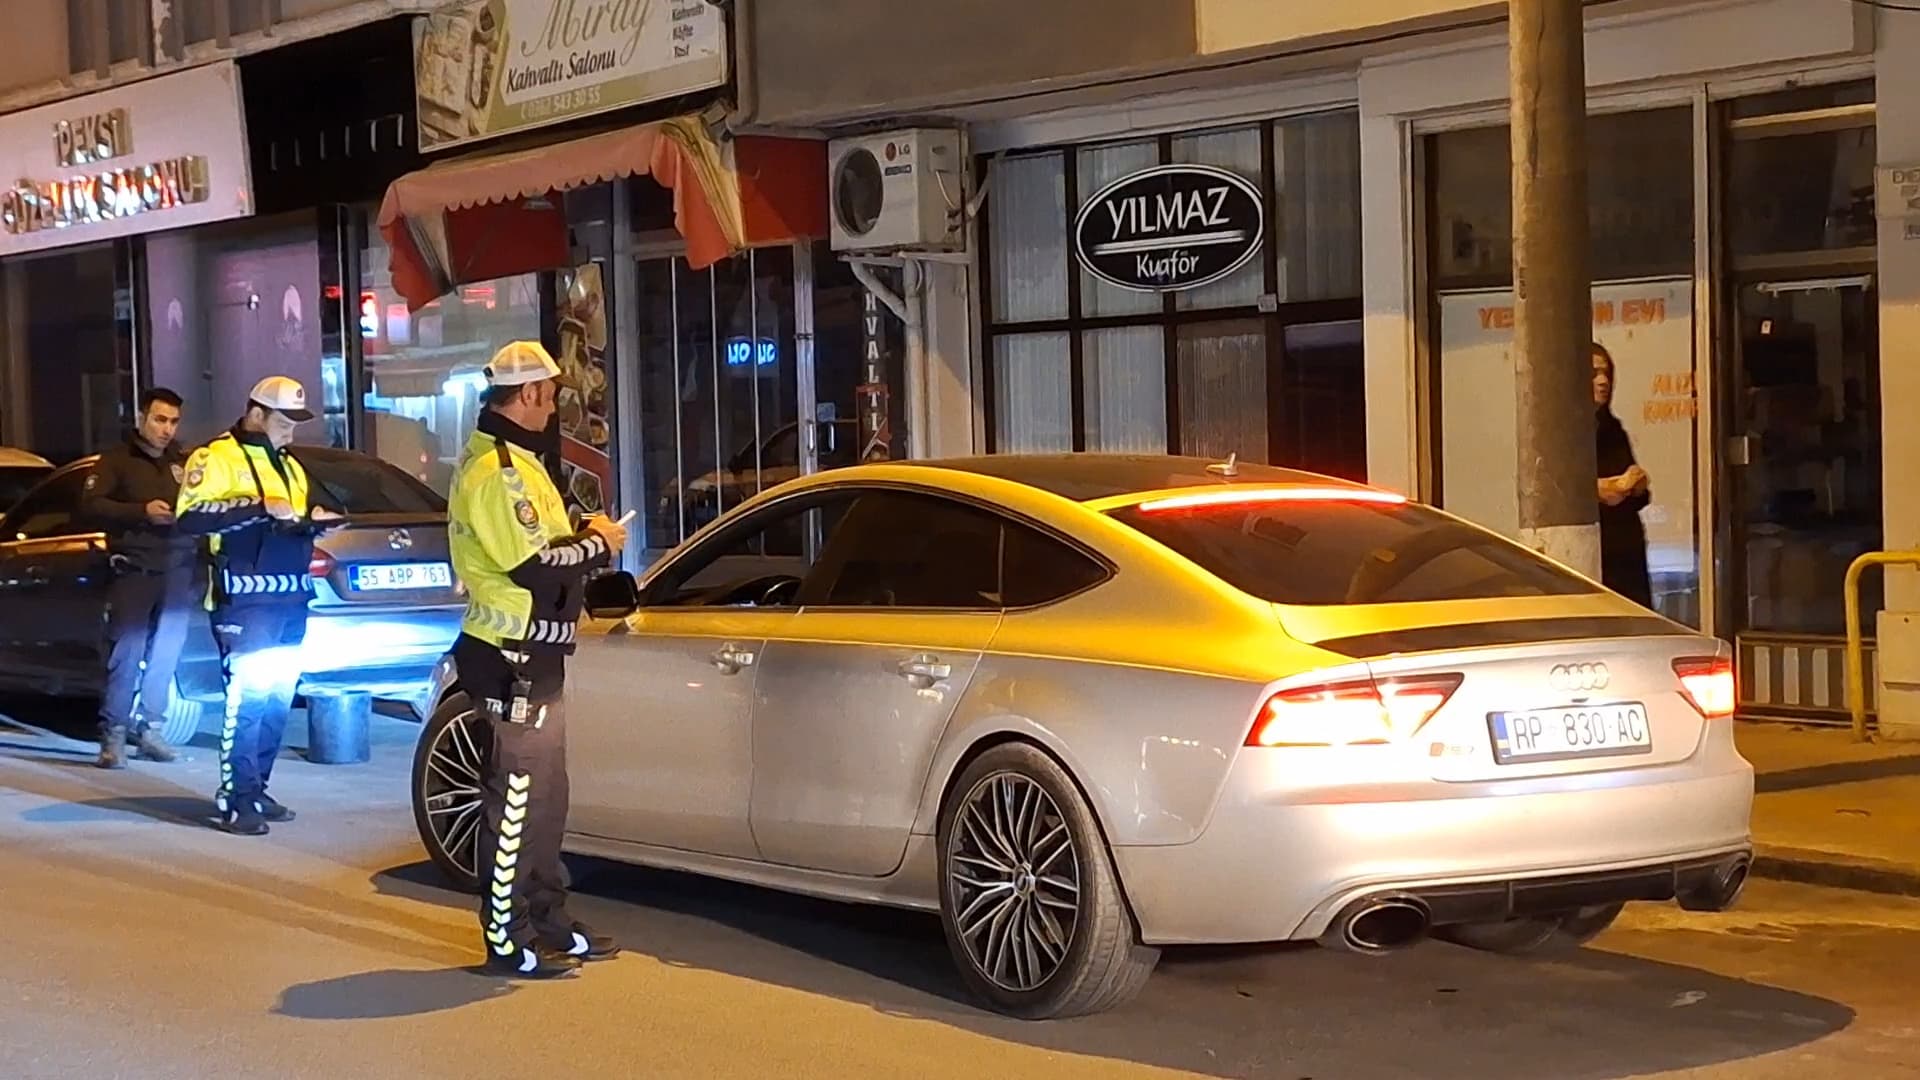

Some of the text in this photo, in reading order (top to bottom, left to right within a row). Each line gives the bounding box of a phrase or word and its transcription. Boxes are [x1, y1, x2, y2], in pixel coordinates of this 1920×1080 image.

[506, 49, 617, 93] Kahvaltı Salonu
[1105, 186, 1231, 240] YILMAZ
[1136, 250, 1200, 280] Kuaför
[361, 566, 447, 586] 55 ABP 763
[1513, 708, 1643, 750] RP 830 AC
